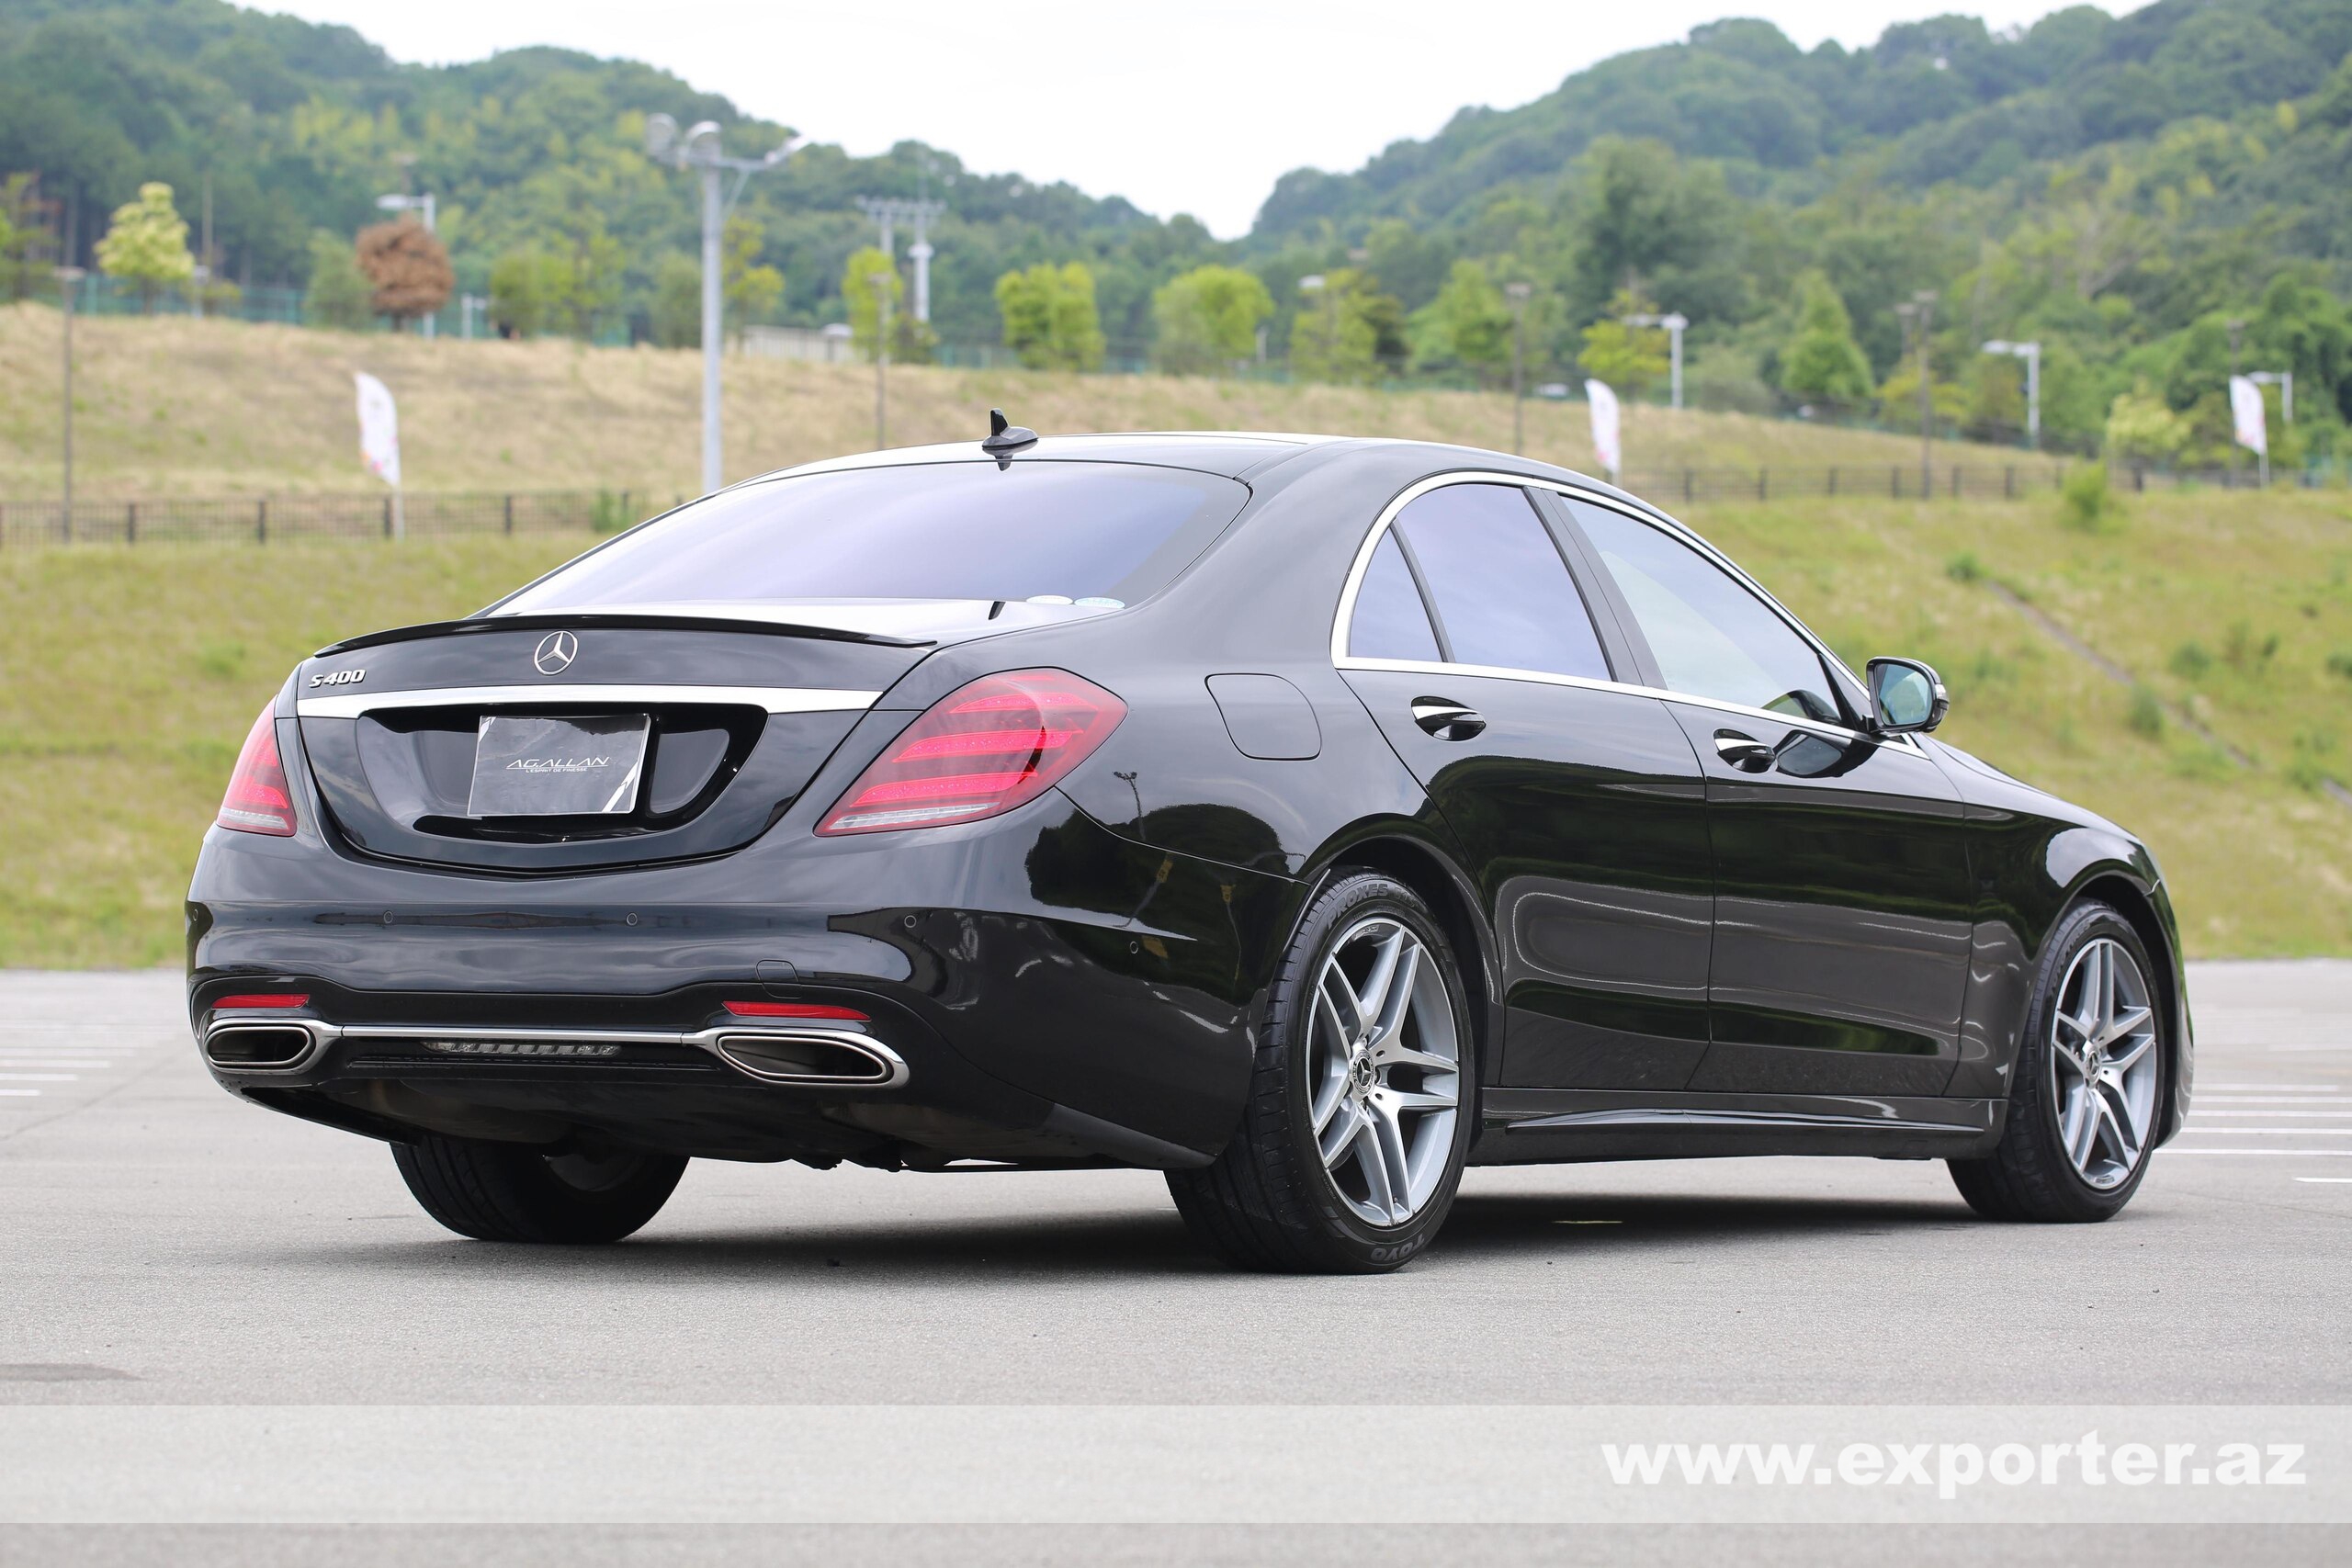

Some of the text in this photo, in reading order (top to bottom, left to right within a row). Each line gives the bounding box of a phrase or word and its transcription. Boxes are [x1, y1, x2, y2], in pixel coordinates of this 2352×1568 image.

[309, 669, 367, 688] S400
[1324, 883, 1388, 931] PROXES
[1370, 1233, 1425, 1261] TOYO
